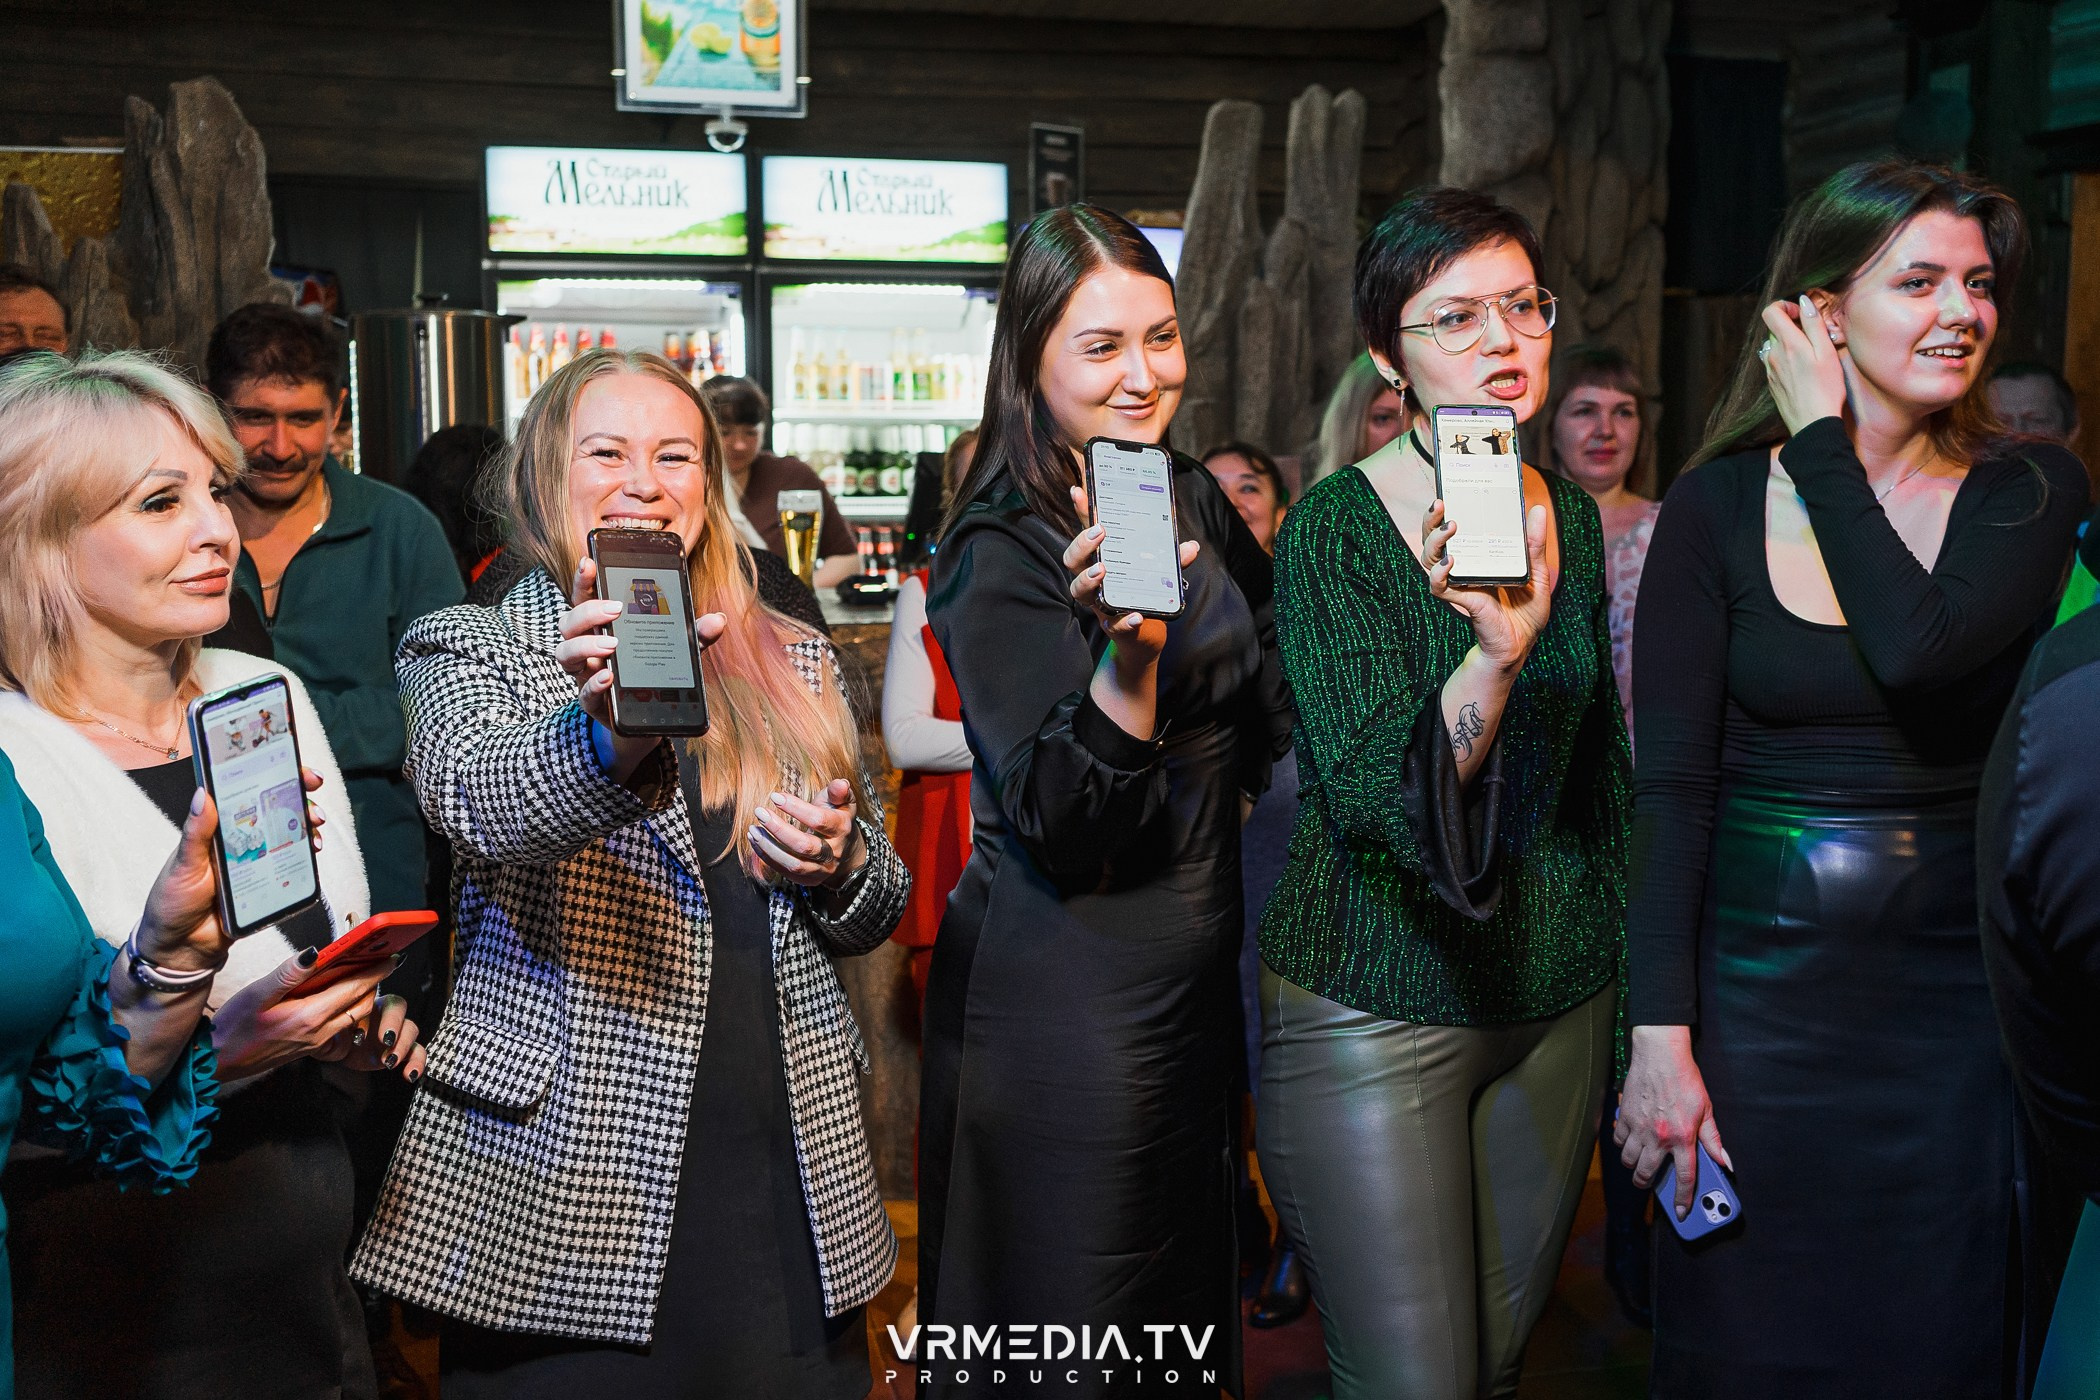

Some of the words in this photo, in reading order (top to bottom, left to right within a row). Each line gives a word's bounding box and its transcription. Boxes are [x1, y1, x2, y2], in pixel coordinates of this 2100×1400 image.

[544, 159, 690, 209] Мельник
[586, 157, 668, 183] Старый
[856, 167, 934, 191] Старый
[817, 169, 955, 218] Мельник
